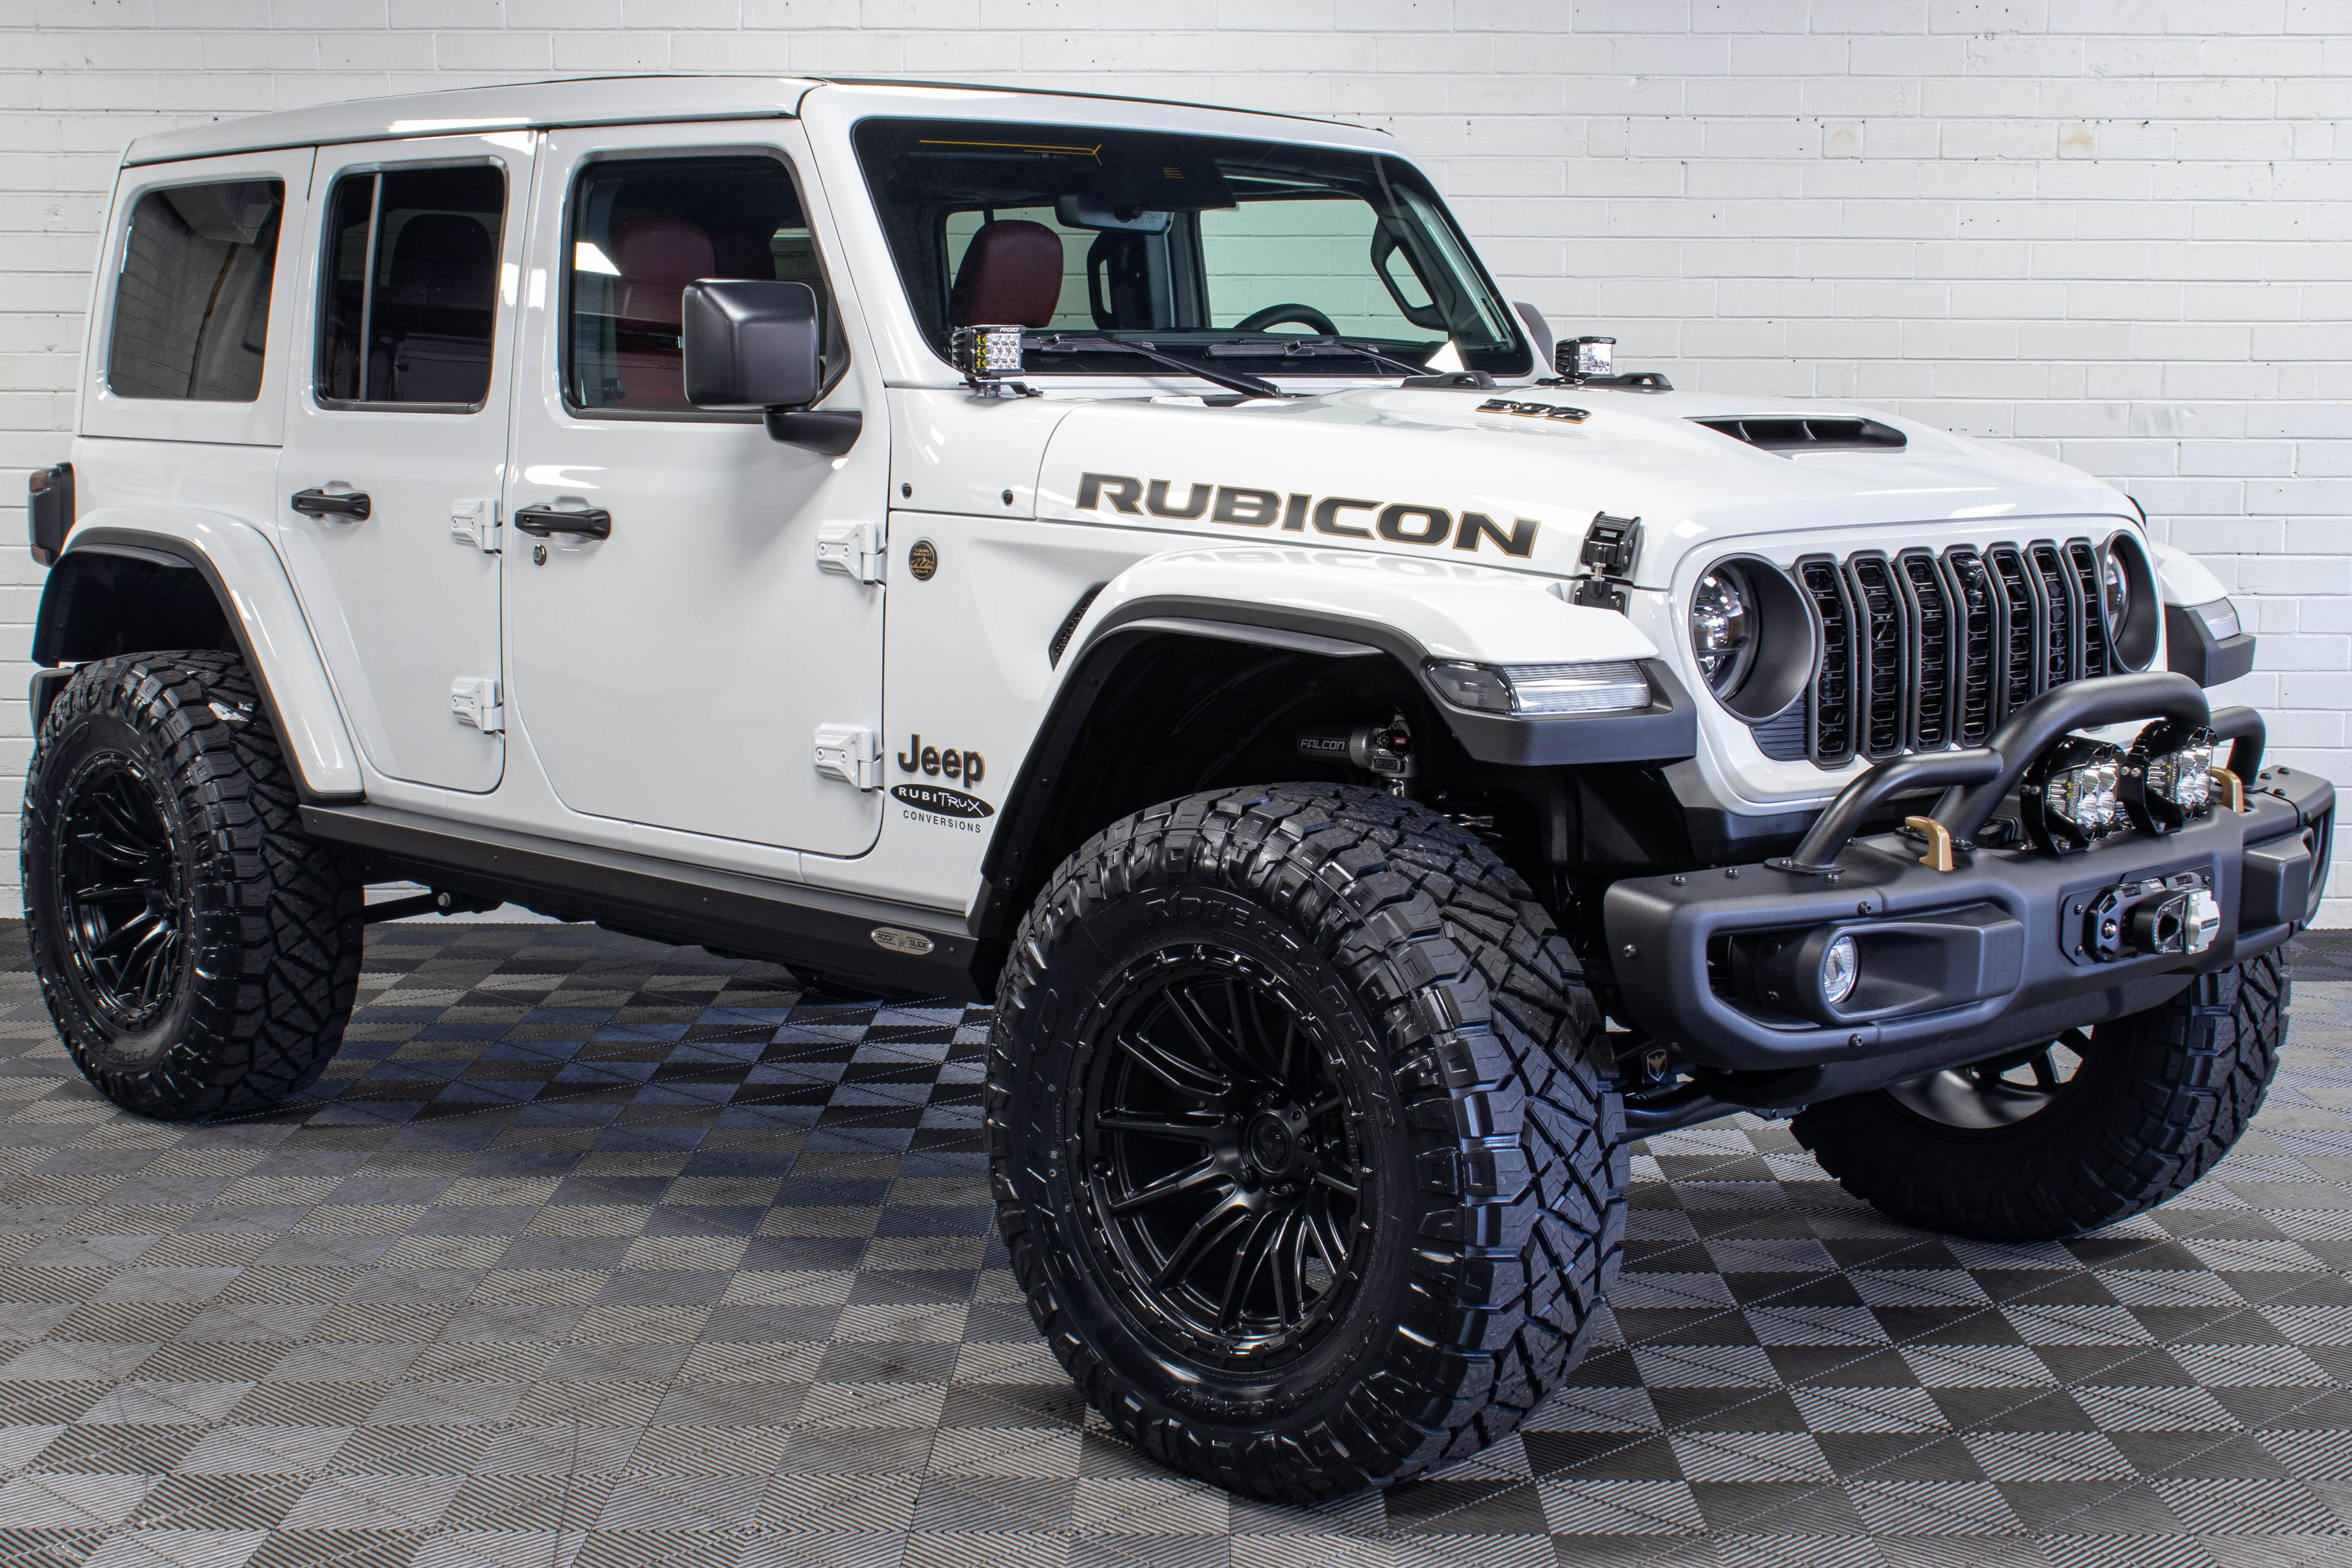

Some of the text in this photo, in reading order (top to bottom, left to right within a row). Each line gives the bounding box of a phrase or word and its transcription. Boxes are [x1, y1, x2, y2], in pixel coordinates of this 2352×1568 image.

[1075, 471, 1541, 559] RUBICON
[1300, 739, 1345, 750] FALCON
[898, 733, 985, 789] Jeep
[903, 810, 981, 833] CONVERSIONS
[877, 933, 927, 949] ROCK SLIDE
